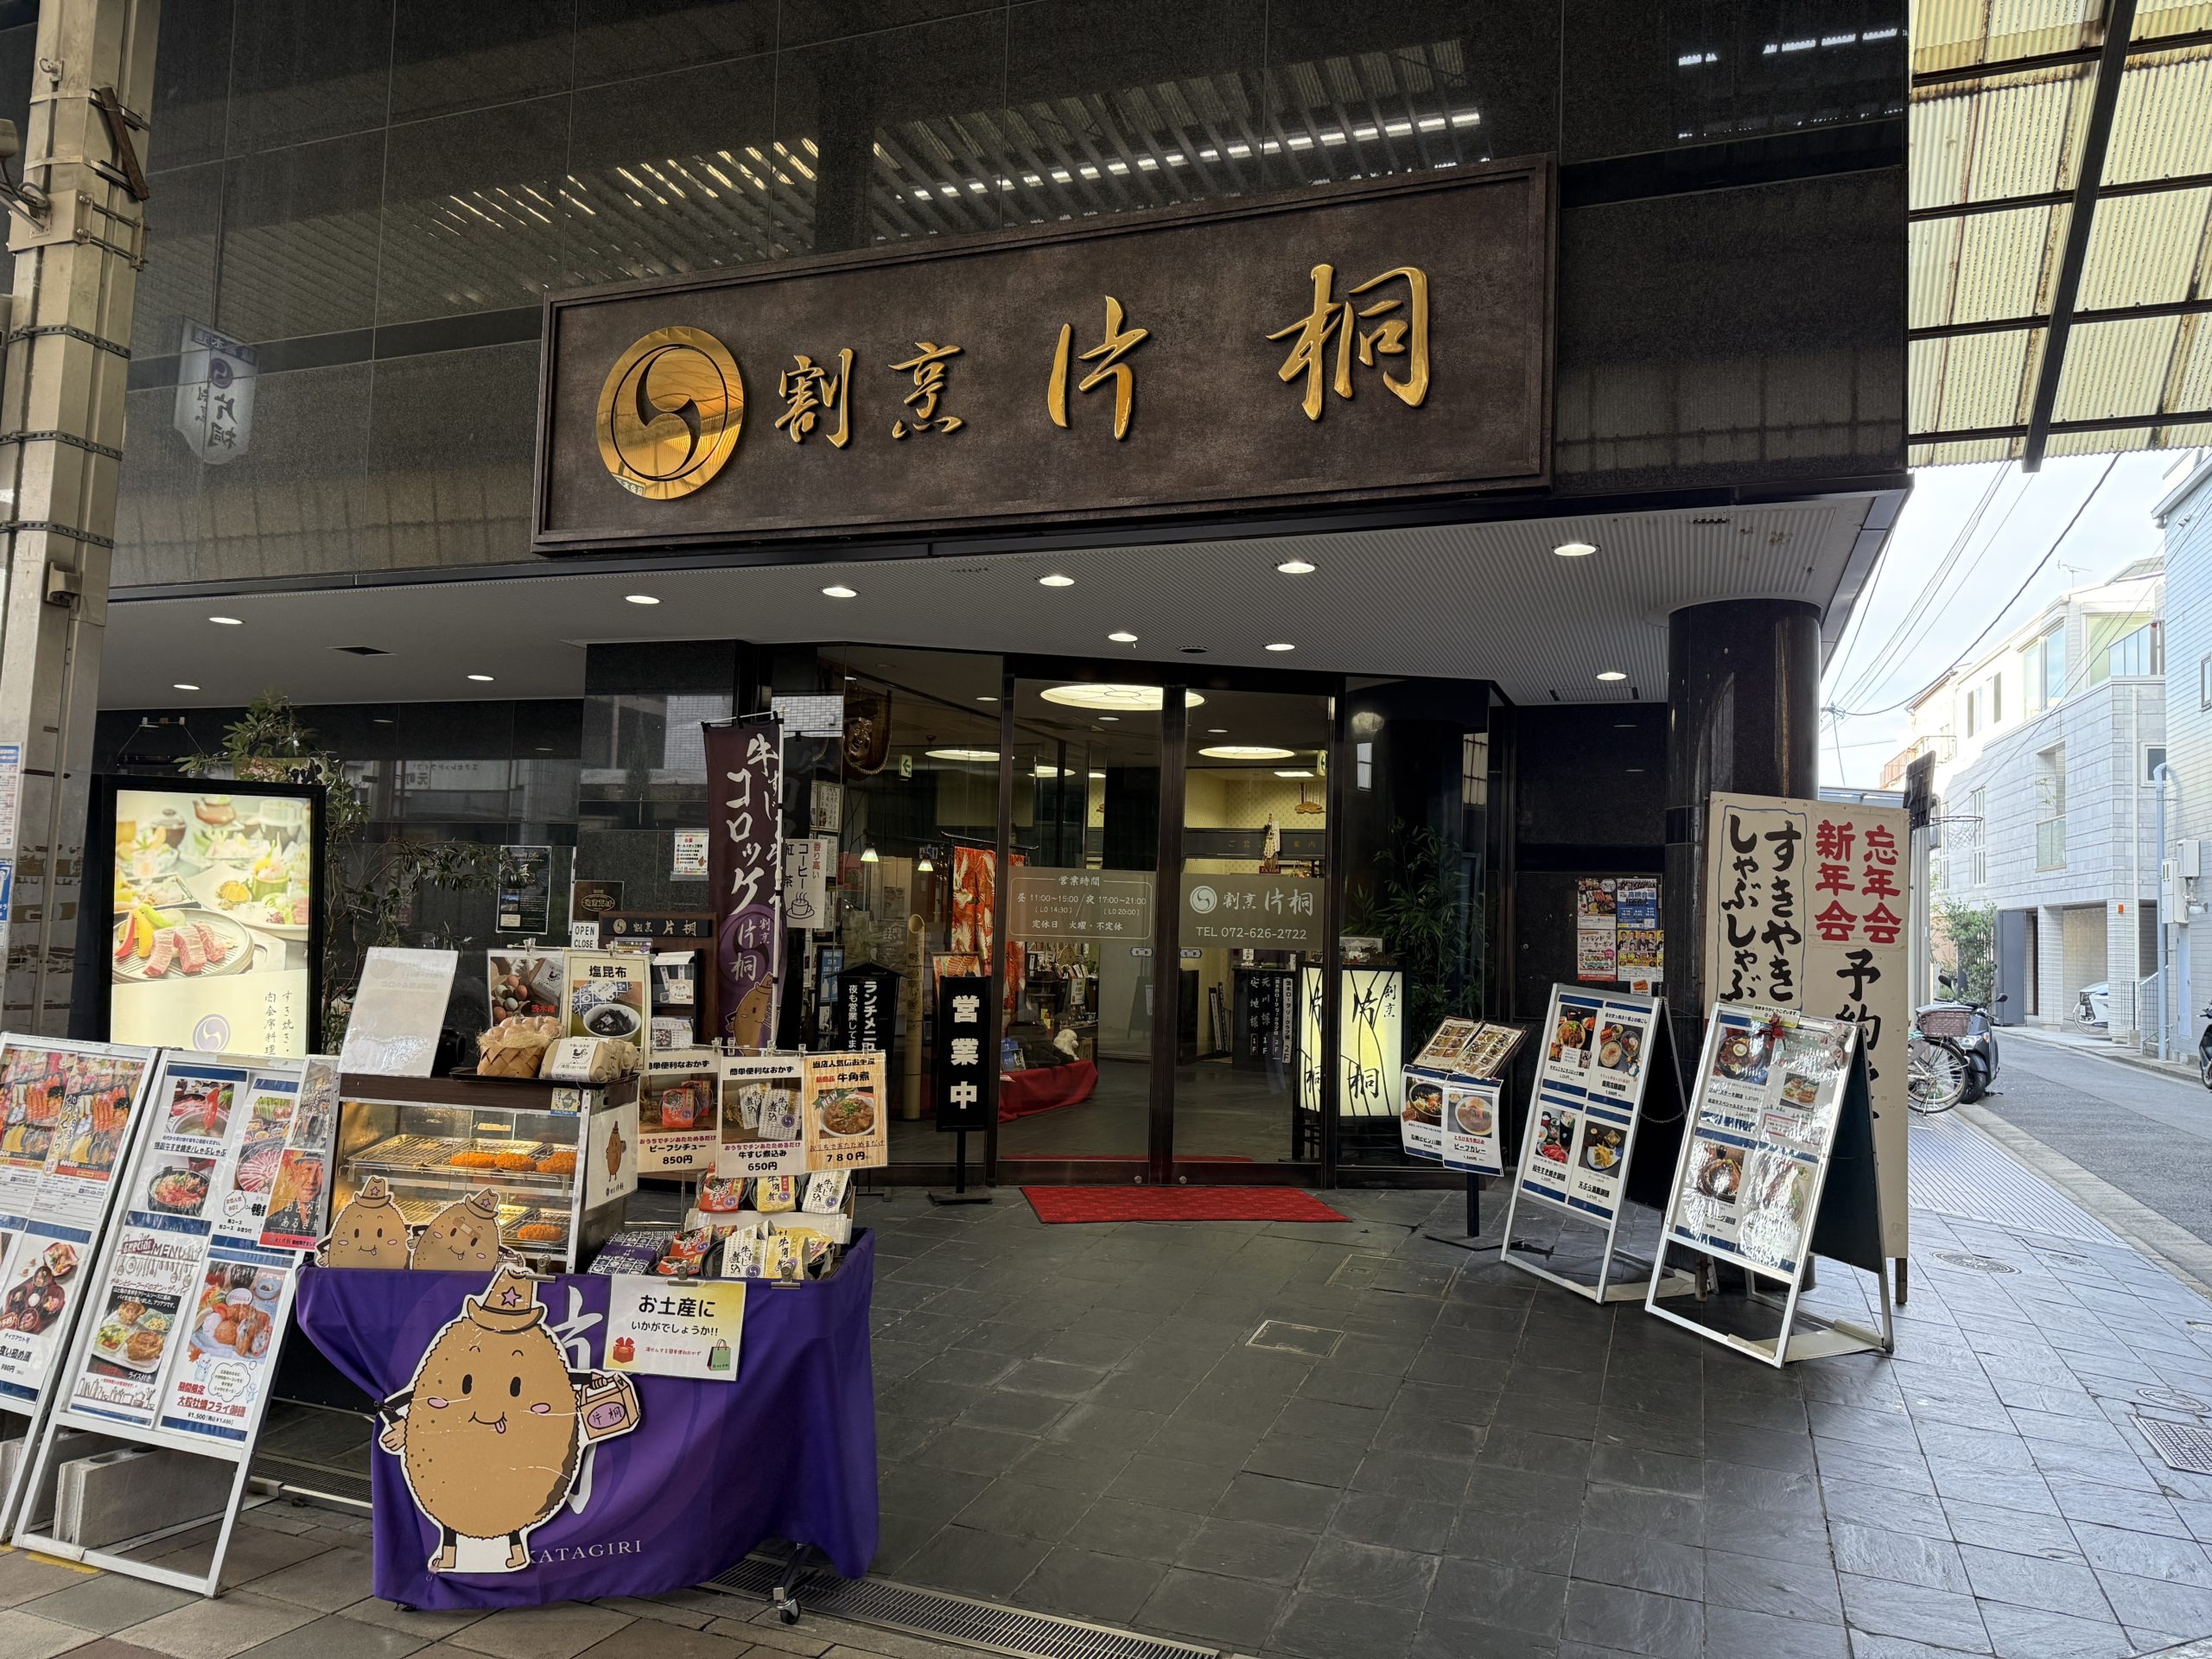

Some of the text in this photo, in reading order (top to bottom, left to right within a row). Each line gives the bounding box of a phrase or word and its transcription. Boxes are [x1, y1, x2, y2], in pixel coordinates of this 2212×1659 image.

[775, 264, 1430, 449] 割烹 片桐
[726, 768, 765, 916] コロッケ
[798, 844, 809, 889] コーヒー
[1058, 875, 1100, 887] 営業時間
[1815, 820, 1857, 941] 新年会
[1862, 824, 1902, 944] 忘年会
[1086, 894, 1095, 905] 夜
[1223, 887, 1313, 917] 割烹 片桐
[1720, 814, 1761, 1001] しゃぶしゃぶ
[1761, 820, 1802, 1001] すきやき
[575, 925, 595, 936] OPEN
[663, 919, 697, 937] 片桐
[1032, 920, 1058, 929] 定休日
[1196, 926, 1307, 940] TEL 072-626-2722
[574, 939, 594, 949] CLOSE
[728, 919, 757, 982] 片桐
[589, 964, 627, 978] 塩昆布
[264, 991, 276, 1056] 肉会席料理
[848, 985, 858, 1051] 夜も営業してま
[1347, 988, 1380, 1099] 片桐
[950, 995, 980, 1109] 営業中
[729, 1065, 795, 1076] 簡単便利なおかず
[837, 1071, 870, 1083] 牛角煮
[822, 1090, 839, 1107] NEW
[639, 1135, 716, 1145] おうちでチンあたためるだけ
[724, 1142, 801, 1151] おうちでチンあたためるだけ
[650, 1143, 707, 1153] ビーフシチュー
[738, 1149, 787, 1159] 牛すじ煮込み
[663, 1154, 693, 1164] 850円
[827, 1151, 865, 1162] 780円
[747, 1161, 778, 1172] 650円
[639, 1294, 716, 1318] お土産に
[631, 1320, 718, 1337] いかがでしょうか!!
[128, 1371, 152, 1382] ライス付き
[177, 1381, 206, 1395] 期間限定
